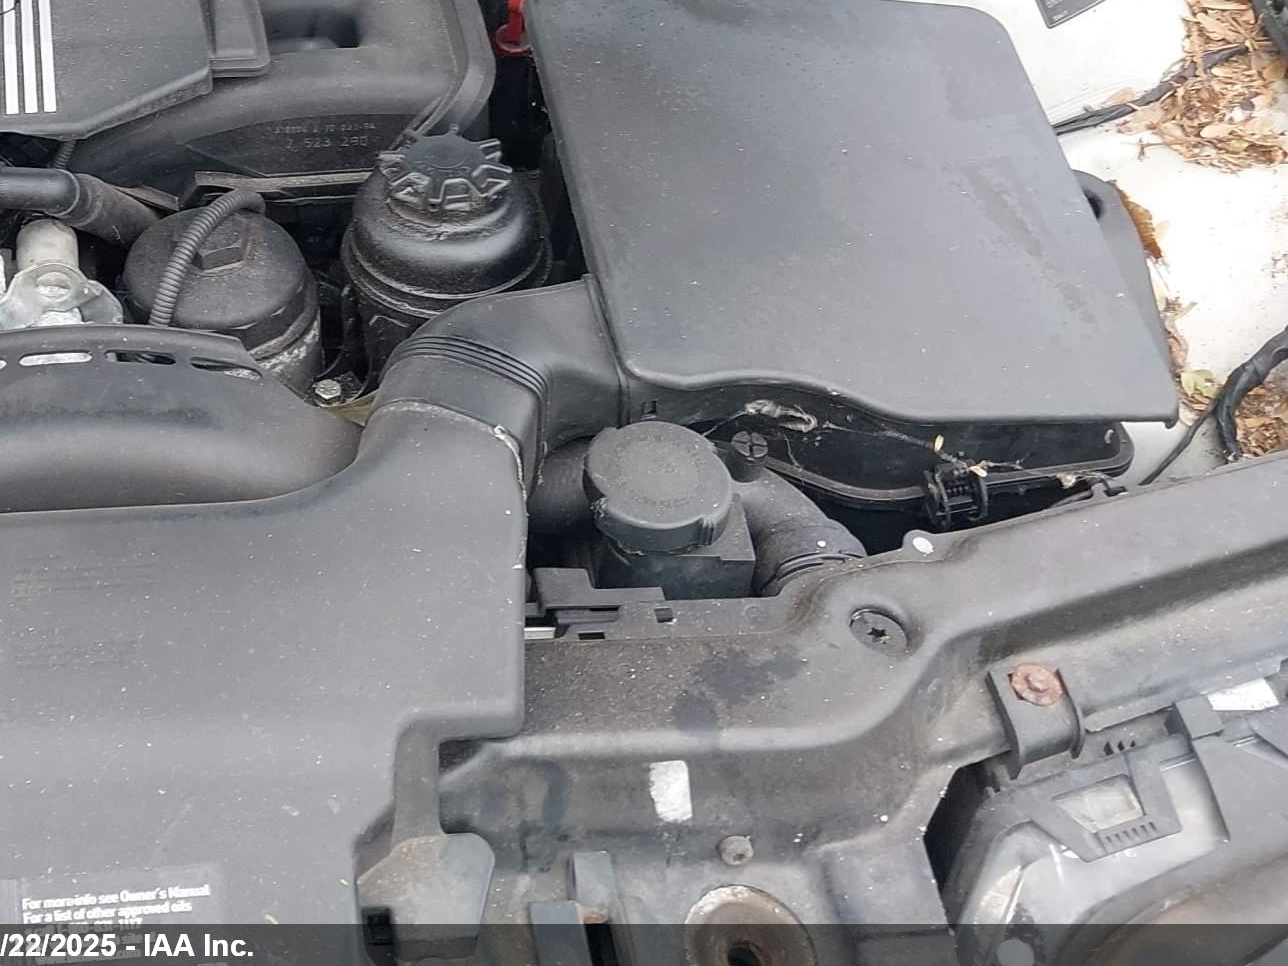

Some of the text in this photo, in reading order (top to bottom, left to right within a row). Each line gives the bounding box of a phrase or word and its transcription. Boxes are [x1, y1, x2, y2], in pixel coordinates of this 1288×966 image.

[21, 897, 43, 911] For
[98, 893, 119, 904] see
[119, 888, 167, 903] Owner's
[168, 884, 211, 899] Manual
[22, 900, 193, 925] For a list of other approved oils
